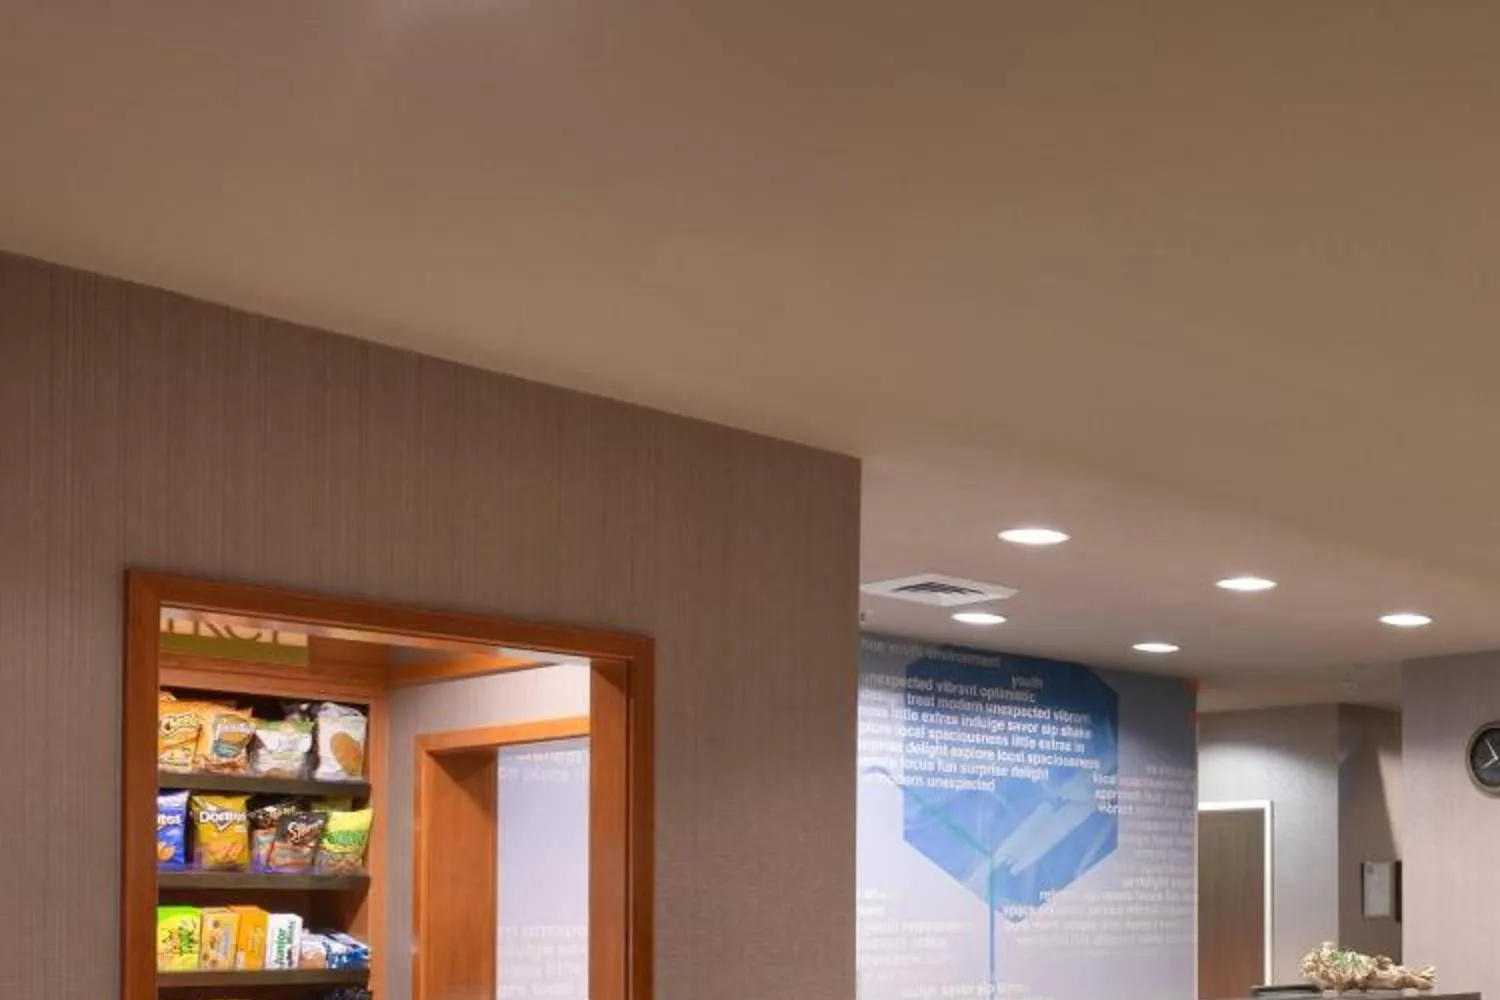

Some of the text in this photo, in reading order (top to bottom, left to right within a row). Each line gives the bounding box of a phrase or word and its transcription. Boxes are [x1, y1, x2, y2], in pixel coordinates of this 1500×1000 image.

[861, 672, 1037, 703] unexpected vibrant optimistic
[921, 711, 960, 725] extras
[961, 713, 1005, 734] indulge
[1006, 720, 1039, 734] savor
[985, 702, 1051, 719] unexpected
[1052, 708, 1091, 724] vibrant
[926, 728, 1009, 747] spaciousness
[1010, 733, 1037, 749] little
[904, 741, 948, 759] delight
[996, 748, 1025, 763] local
[1026, 753, 1100, 770] spaciousness
[959, 763, 1009, 779] surprise
[926, 776, 996, 793] unexpected
